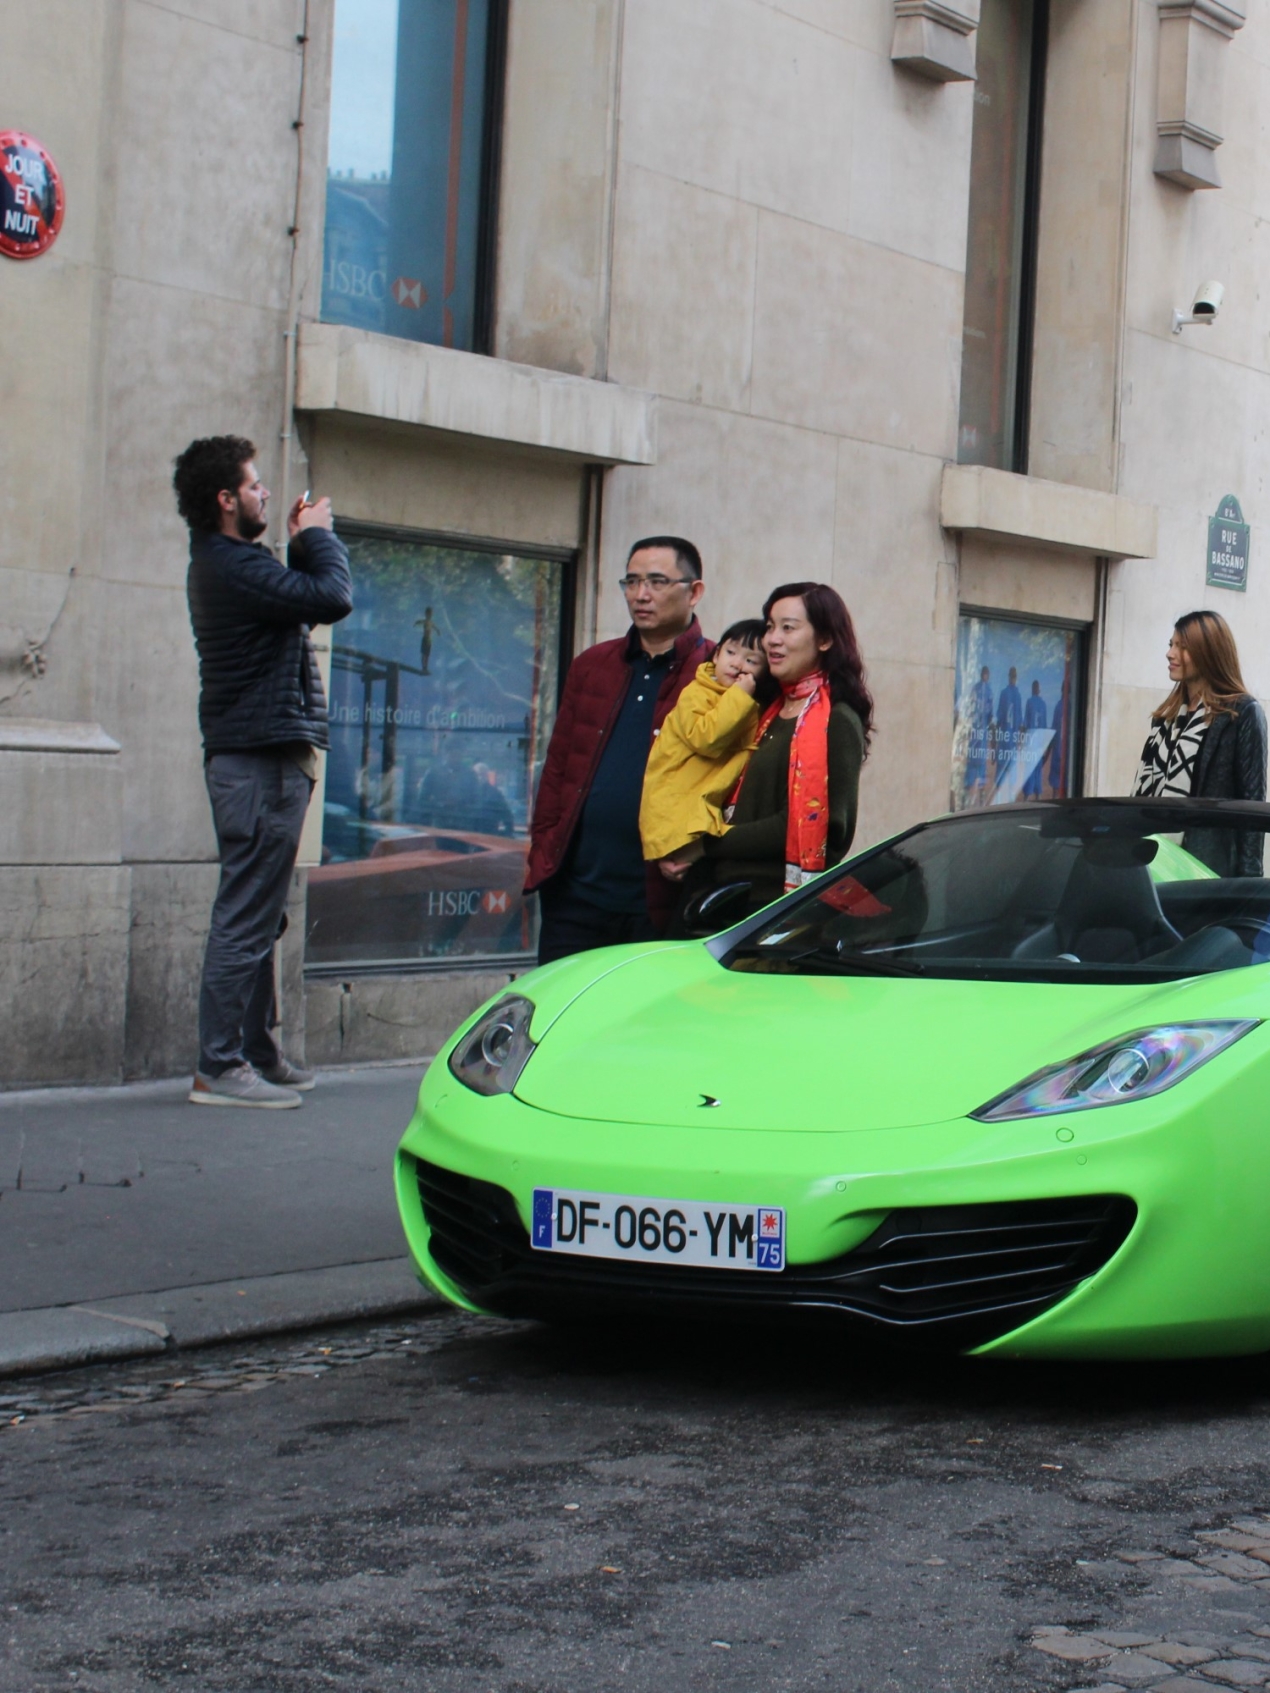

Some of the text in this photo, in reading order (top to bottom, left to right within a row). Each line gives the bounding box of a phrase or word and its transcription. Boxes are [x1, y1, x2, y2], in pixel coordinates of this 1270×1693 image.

[5, 154, 45, 177] JOUR
[15, 184, 34, 206] ET
[4, 209, 39, 236] NUIT
[1221, 529, 1238, 546] RUE
[1211, 551, 1245, 570] BASSANO
[328, 701, 506, 728] Une histoire d'ambition
[995, 727, 1010, 743] the
[1012, 731, 1034, 746] story
[966, 747, 996, 760] human
[428, 891, 480, 916] HSBC
[538, 1225, 546, 1239] F
[556, 1198, 754, 1259] DF-066-YM
[759, 1243, 780, 1265] 75
